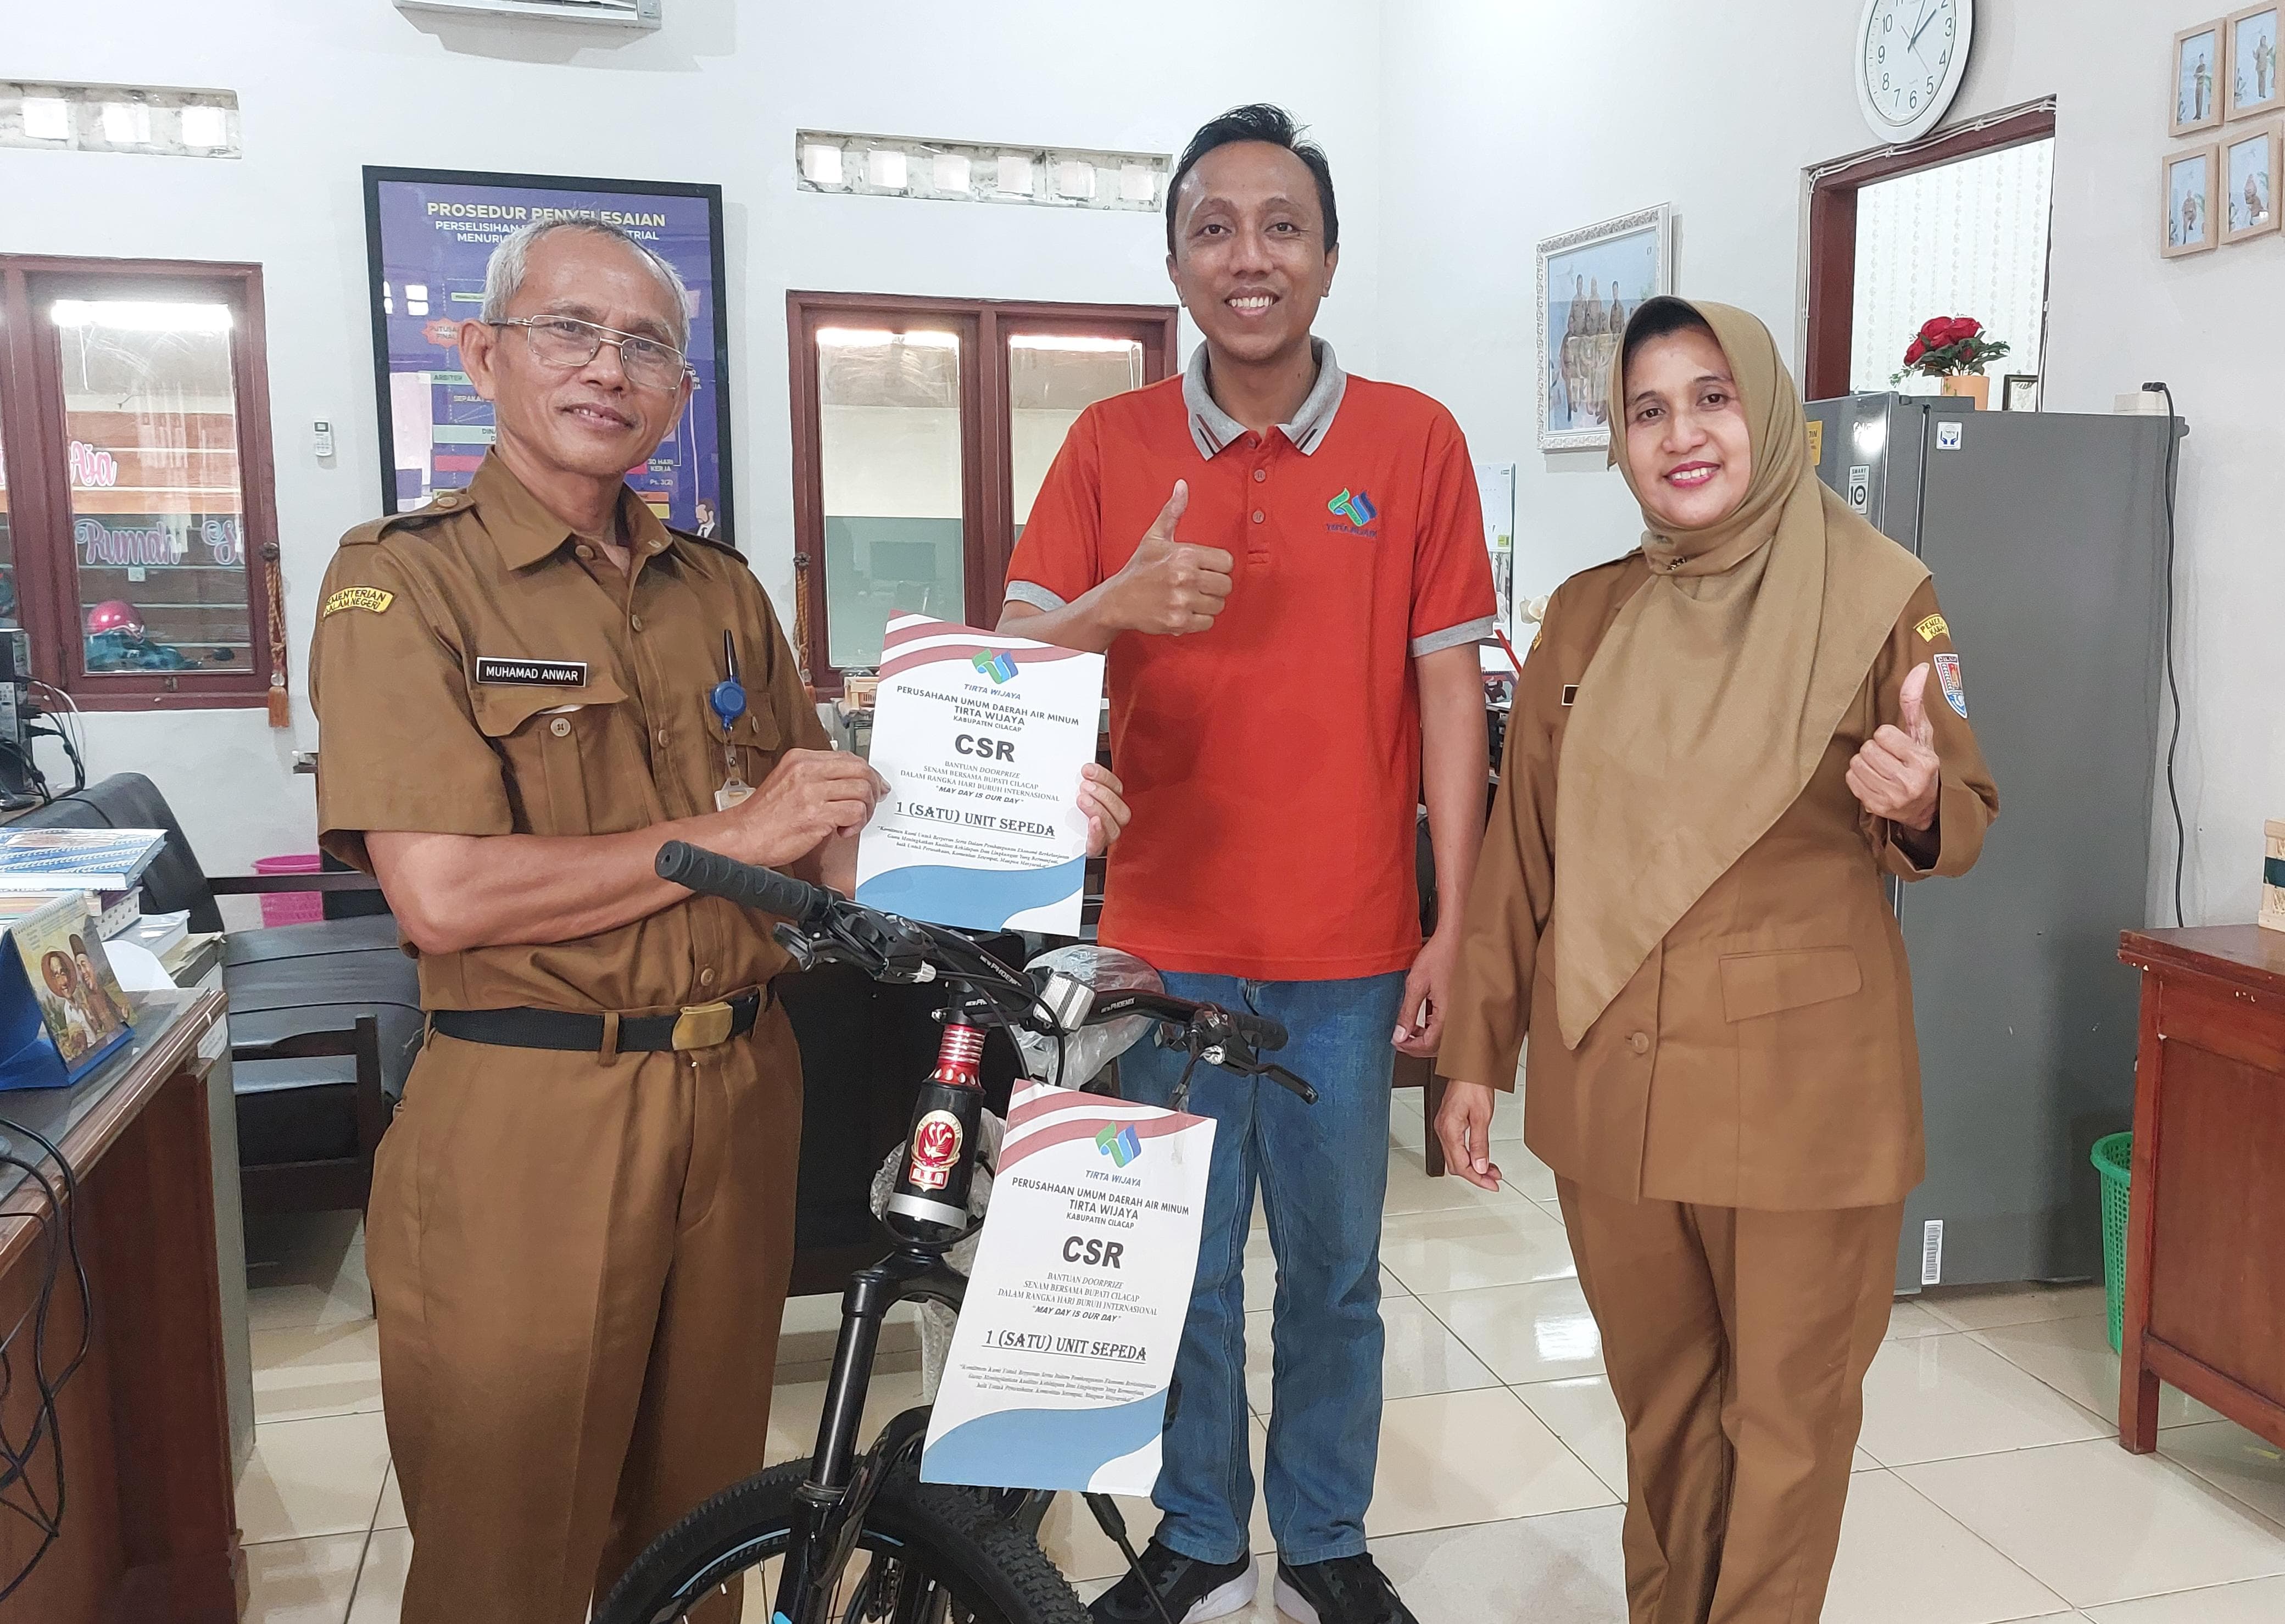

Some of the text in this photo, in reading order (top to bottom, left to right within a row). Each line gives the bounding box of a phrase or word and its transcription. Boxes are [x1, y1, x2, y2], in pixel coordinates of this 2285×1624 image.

[1882, 14, 1952, 37] 10 3
[1878, 45, 1946, 65] 9 4
[1882, 72, 1933, 94] 8 5
[1894, 88, 1917, 109] 7 6
[427, 202, 665, 227] PROSEDUR PENYELESAIAN
[436, 221, 519, 233] PERSELISIHAN
[626, 230, 660, 240] TRIAL
[1851, 485, 1866, 505] 10
[350, 598, 381, 610] NEGERI
[486, 665, 578, 682] MUHAMAD ANWAR
[964, 683, 1021, 700] TIRTA WIJAYA
[897, 685, 1079, 726] PERUSAHAAN UMUM DAERAH AIR MINUM
[954, 706, 1025, 726] TIRTA WIJAYA
[954, 715, 1022, 732] KABUPATEN CILACAP
[955, 734, 1015, 763] CSR
[923, 766, 1039, 790] SENAM BERSAMA BUPATI CILACAP
[945, 761, 1021, 779] BANTUAN DOORPRIZE
[900, 769, 1060, 801] DALAM RANGKA HARI BURUH INTERNASIONAL
[985, 794, 1002, 802] OUR
[896, 801, 1056, 837] 1 (SATU) UNIT SEPEDA
[1085, 1169, 1141, 1187] TIRTA WIJAYA
[1012, 1176, 1189, 1215] PERUSAHAAN UMUM DAERAH AIR MINUM
[1069, 1199, 1139, 1220] TIRTA WIJAYA
[1066, 1212, 1134, 1230] KABUPATEN CILACAP
[1063, 1236, 1124, 1269] CSR
[1024, 1280, 1140, 1302] SENAM BERSAMA BUPATI CILACAP
[1047, 1272, 1124, 1290] BANTUAN DOORPRIZE
[997, 1288, 1158, 1316] DALAM RANGKA HARI BURUH INTERNASIONAL
[1055, 1308, 1071, 1316] DAY
[1082, 1312, 1100, 1320] OUR
[985, 1330, 1147, 1361] 1 (SATU) UNIT SEPEDA
